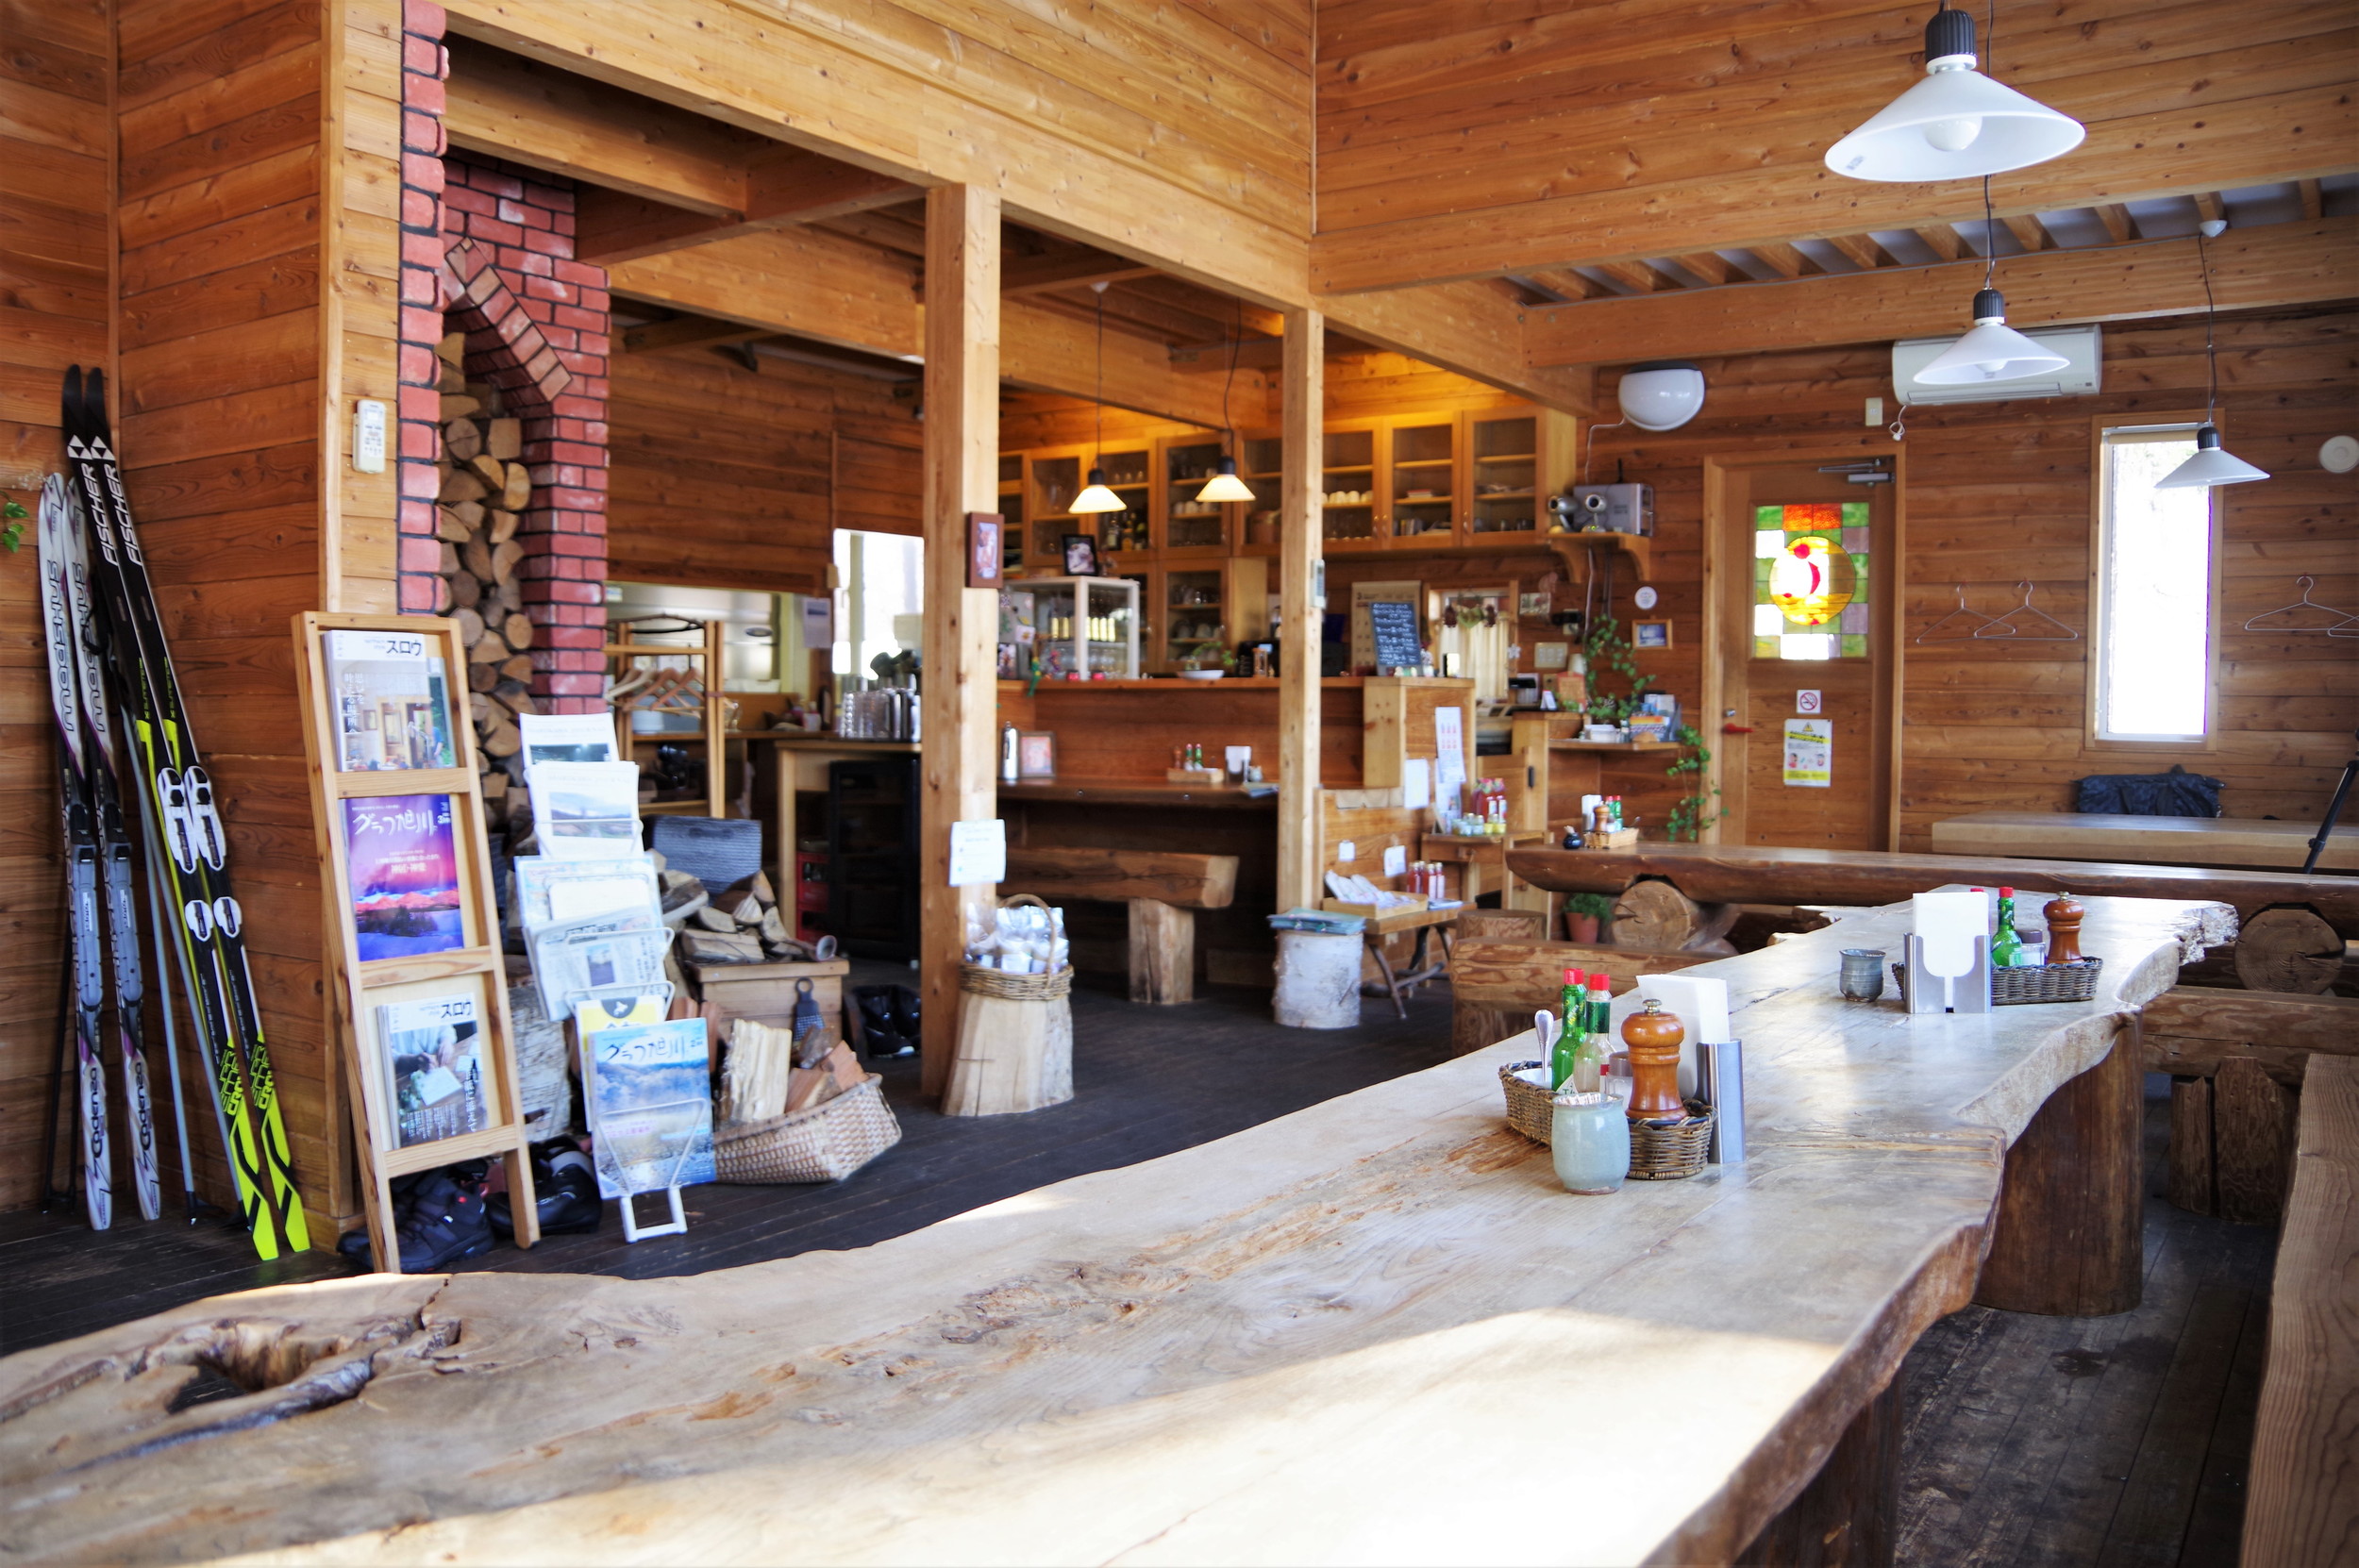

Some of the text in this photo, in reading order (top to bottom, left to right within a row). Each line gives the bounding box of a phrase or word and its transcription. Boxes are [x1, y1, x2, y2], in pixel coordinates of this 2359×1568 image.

[81, 462, 119, 566] FISCHER
[104, 463, 143, 566] FISCHER
[386, 639, 423, 657] スロウ
[353, 809, 434, 837] グラフ旭川
[441, 998, 472, 1019] スロウ
[603, 1036, 686, 1062] グラフ旭川
[89, 1067, 104, 1159] Cadenza
[134, 1061, 151, 1151] Cadenza
